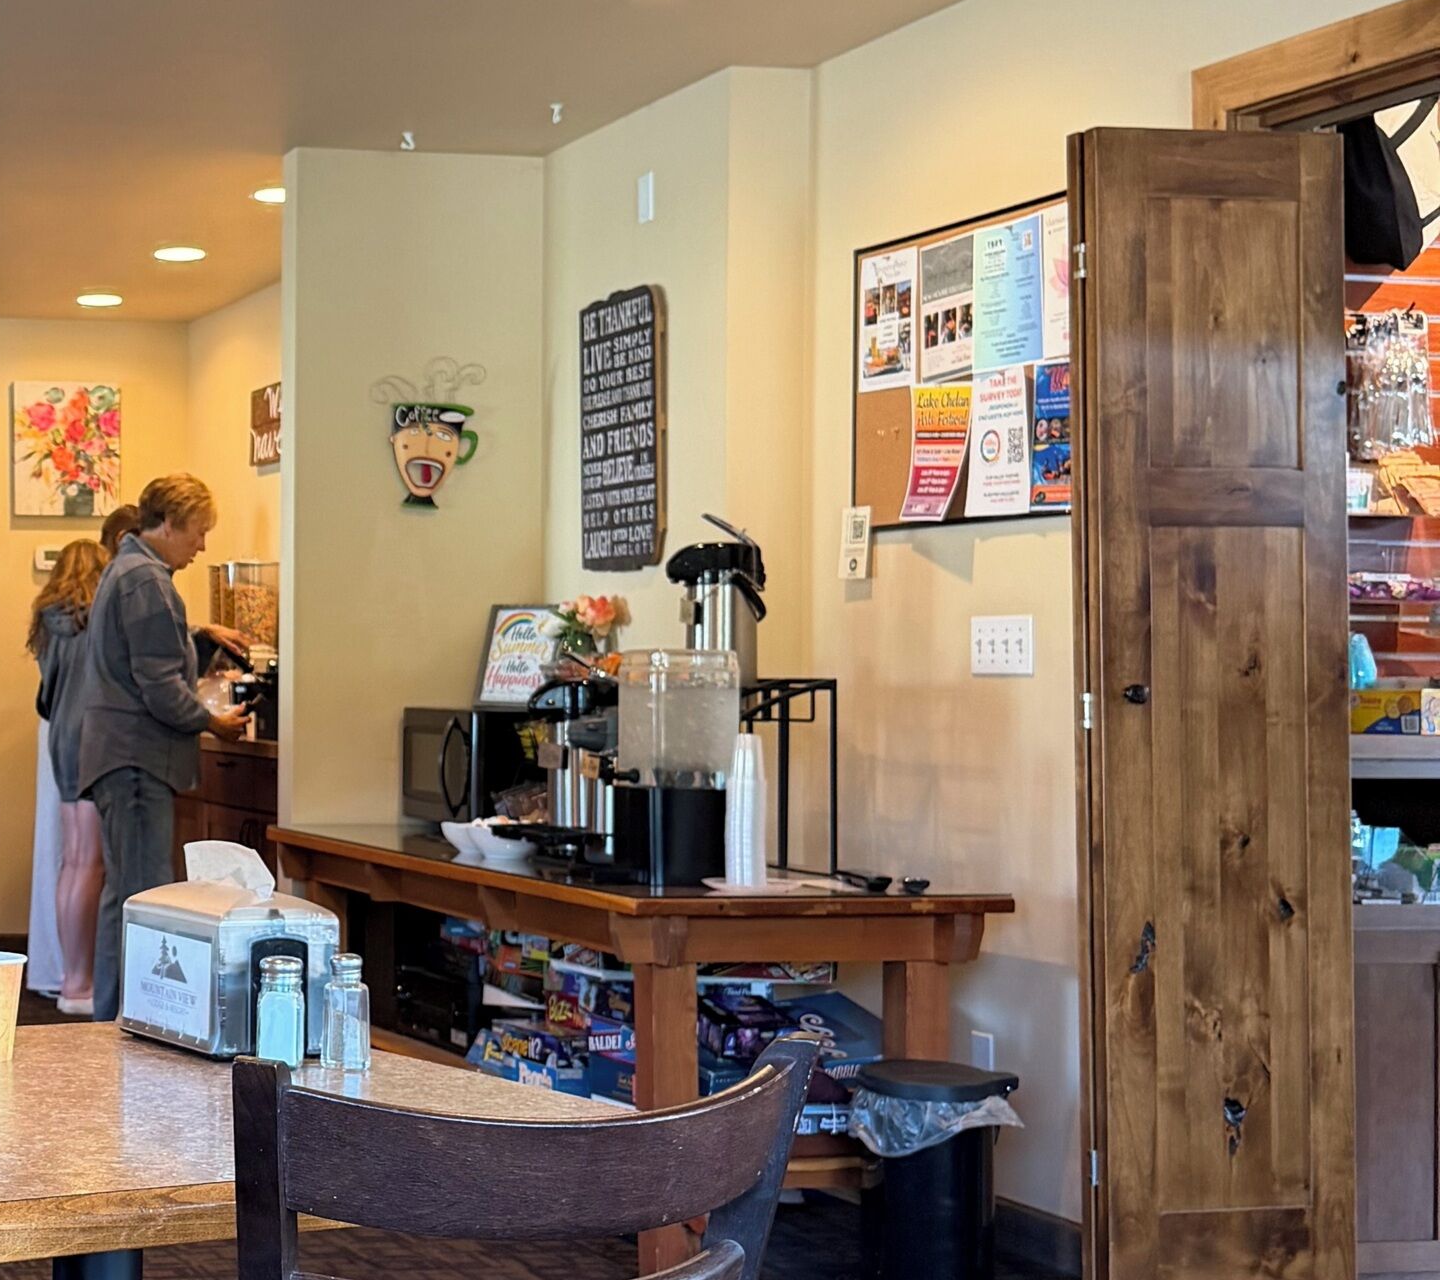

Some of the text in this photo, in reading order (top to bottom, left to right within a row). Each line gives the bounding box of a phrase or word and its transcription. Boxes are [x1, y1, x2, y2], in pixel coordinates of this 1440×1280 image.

[583, 294, 652, 342] BE THANKFUL
[583, 328, 652, 375] LIVE SIMPLY
[613, 344, 652, 369] BE KIND
[583, 362, 651, 394] DO YOUR BEST
[916, 390, 969, 409] Lake Chelan
[980, 390, 1005, 402] SURVEY
[395, 405, 439, 427] Coffee
[583, 399, 653, 431] CHERISH FAMILY
[916, 409, 968, 426] Arts Festival
[583, 421, 653, 459] AND FRIENDS
[603, 455, 634, 486] BELIEVE
[583, 492, 604, 510] LISTEN
[636, 484, 655, 501] HEART
[583, 503, 654, 528] HELP OTHERS
[584, 529, 611, 559] LAUGH
[629, 524, 653, 542] LOVE
[511, 625, 537, 641] Hello
[490, 639, 549, 662] Summer
[486, 664, 541, 690] Happiness
[506, 658, 529, 673] Hello
[140, 980, 198, 1006] MOUNTAIN VIEW
